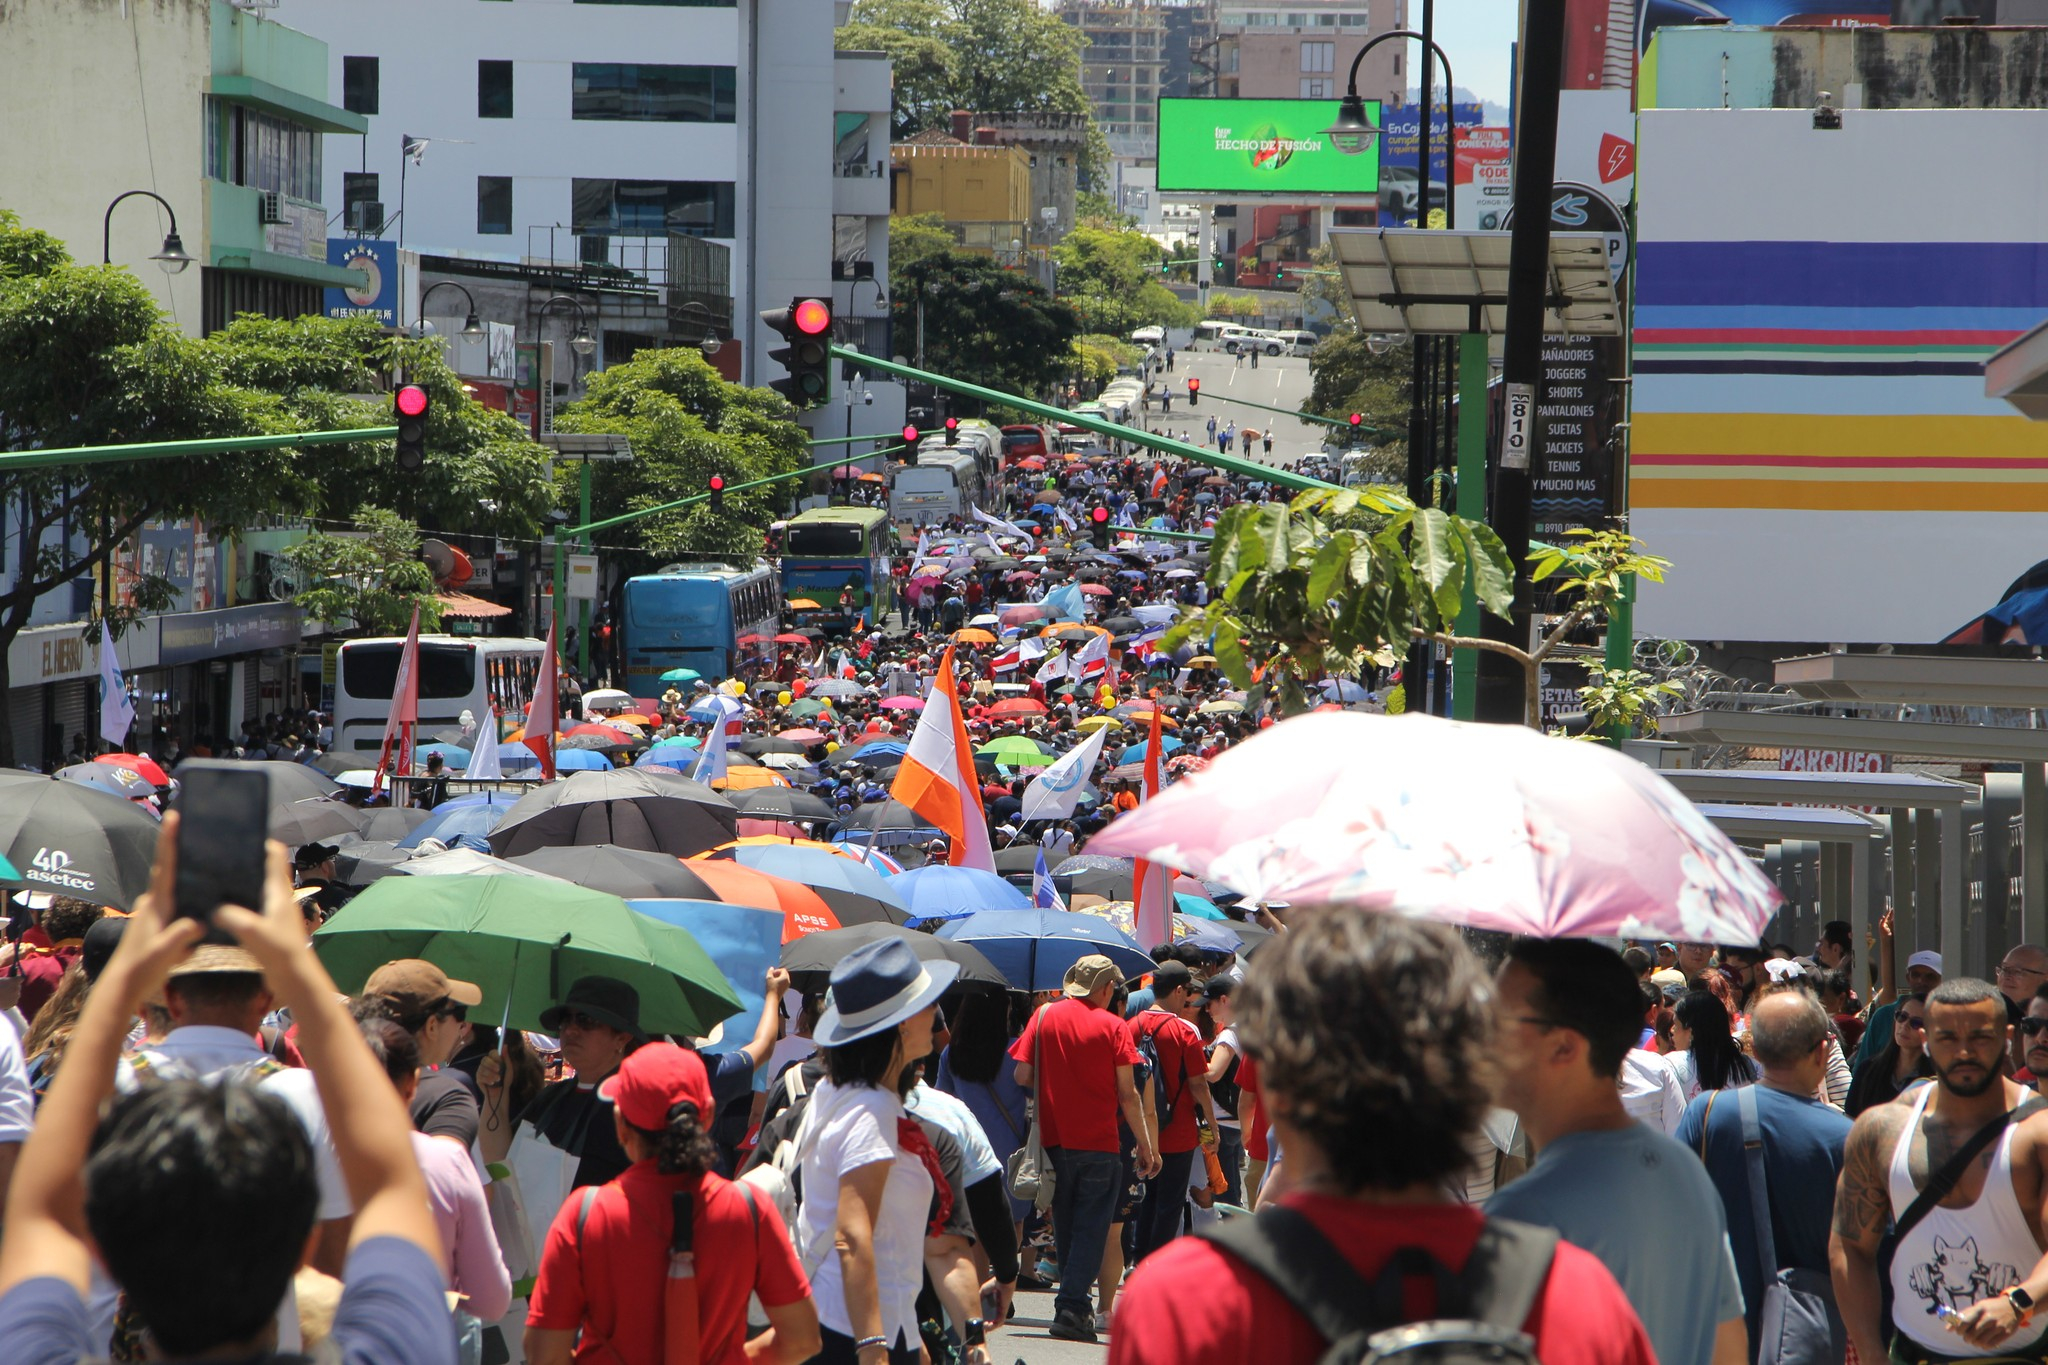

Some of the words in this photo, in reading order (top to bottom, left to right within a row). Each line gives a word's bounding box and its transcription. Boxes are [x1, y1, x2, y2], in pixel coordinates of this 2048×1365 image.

[1388, 123, 1400, 133] En
[1402, 123, 1420, 136] Caj
[1215, 140, 1259, 151] HECHO
[1260, 140, 1276, 151] DE
[1278, 138, 1322, 151] FUSIÓN
[1495, 167, 1509, 178] DE
[1542, 335, 1592, 343] CAMIETAS
[1545, 368, 1587, 380] JOGGERS
[1548, 386, 1583, 398] SHORTS
[1537, 405, 1595, 417] PANTALONES
[1548, 423, 1582, 435] SUETAS
[1545, 442, 1584, 453] JACKETS
[1548, 460, 1581, 472] TENNIS
[1532, 479, 1539, 490] Y
[1540, 479, 1574, 490] MUCHO
[1576, 479, 1596, 490] MAS
[32, 847, 69, 871] 40
[26, 869, 95, 891] asetec
[793, 912, 829, 927] APSE
